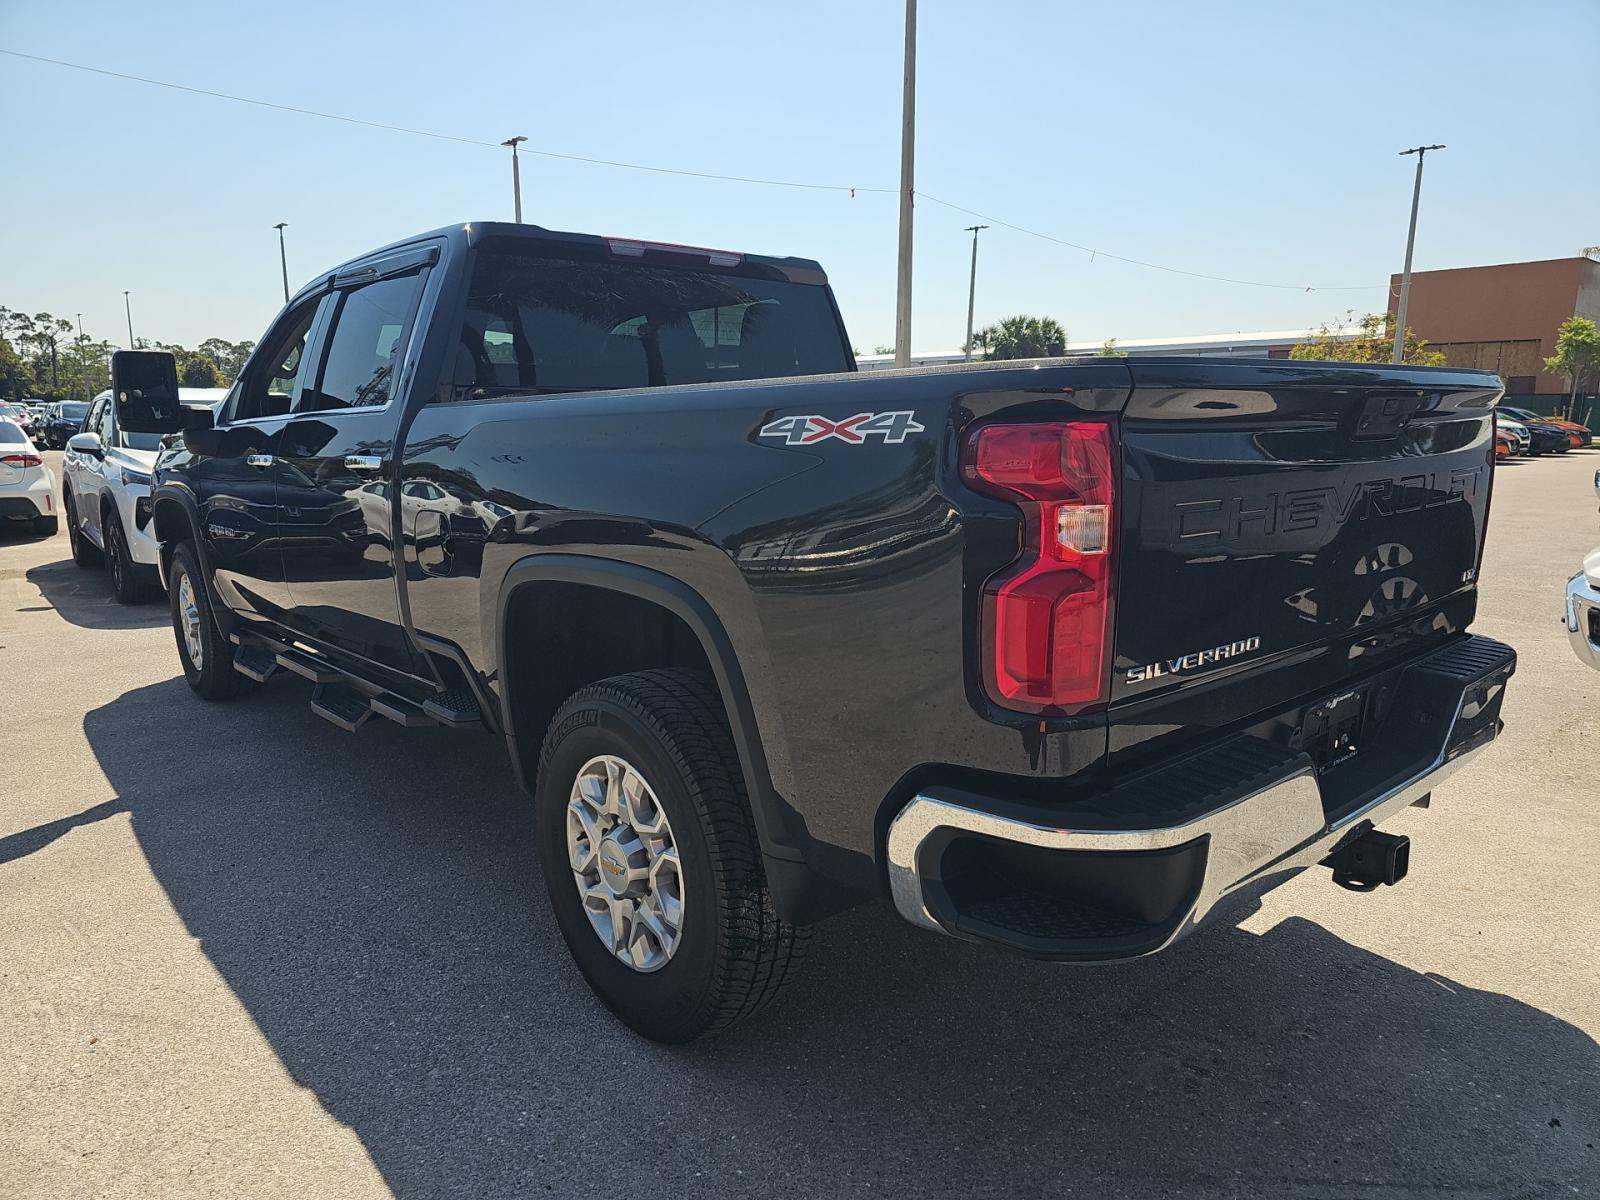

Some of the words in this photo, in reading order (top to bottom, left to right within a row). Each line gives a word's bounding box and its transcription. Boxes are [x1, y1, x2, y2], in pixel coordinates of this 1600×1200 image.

[759, 410, 926, 445] 4X4
[1175, 466, 1483, 541] CHEVROLET
[1125, 636, 1261, 684] SILVERADO
